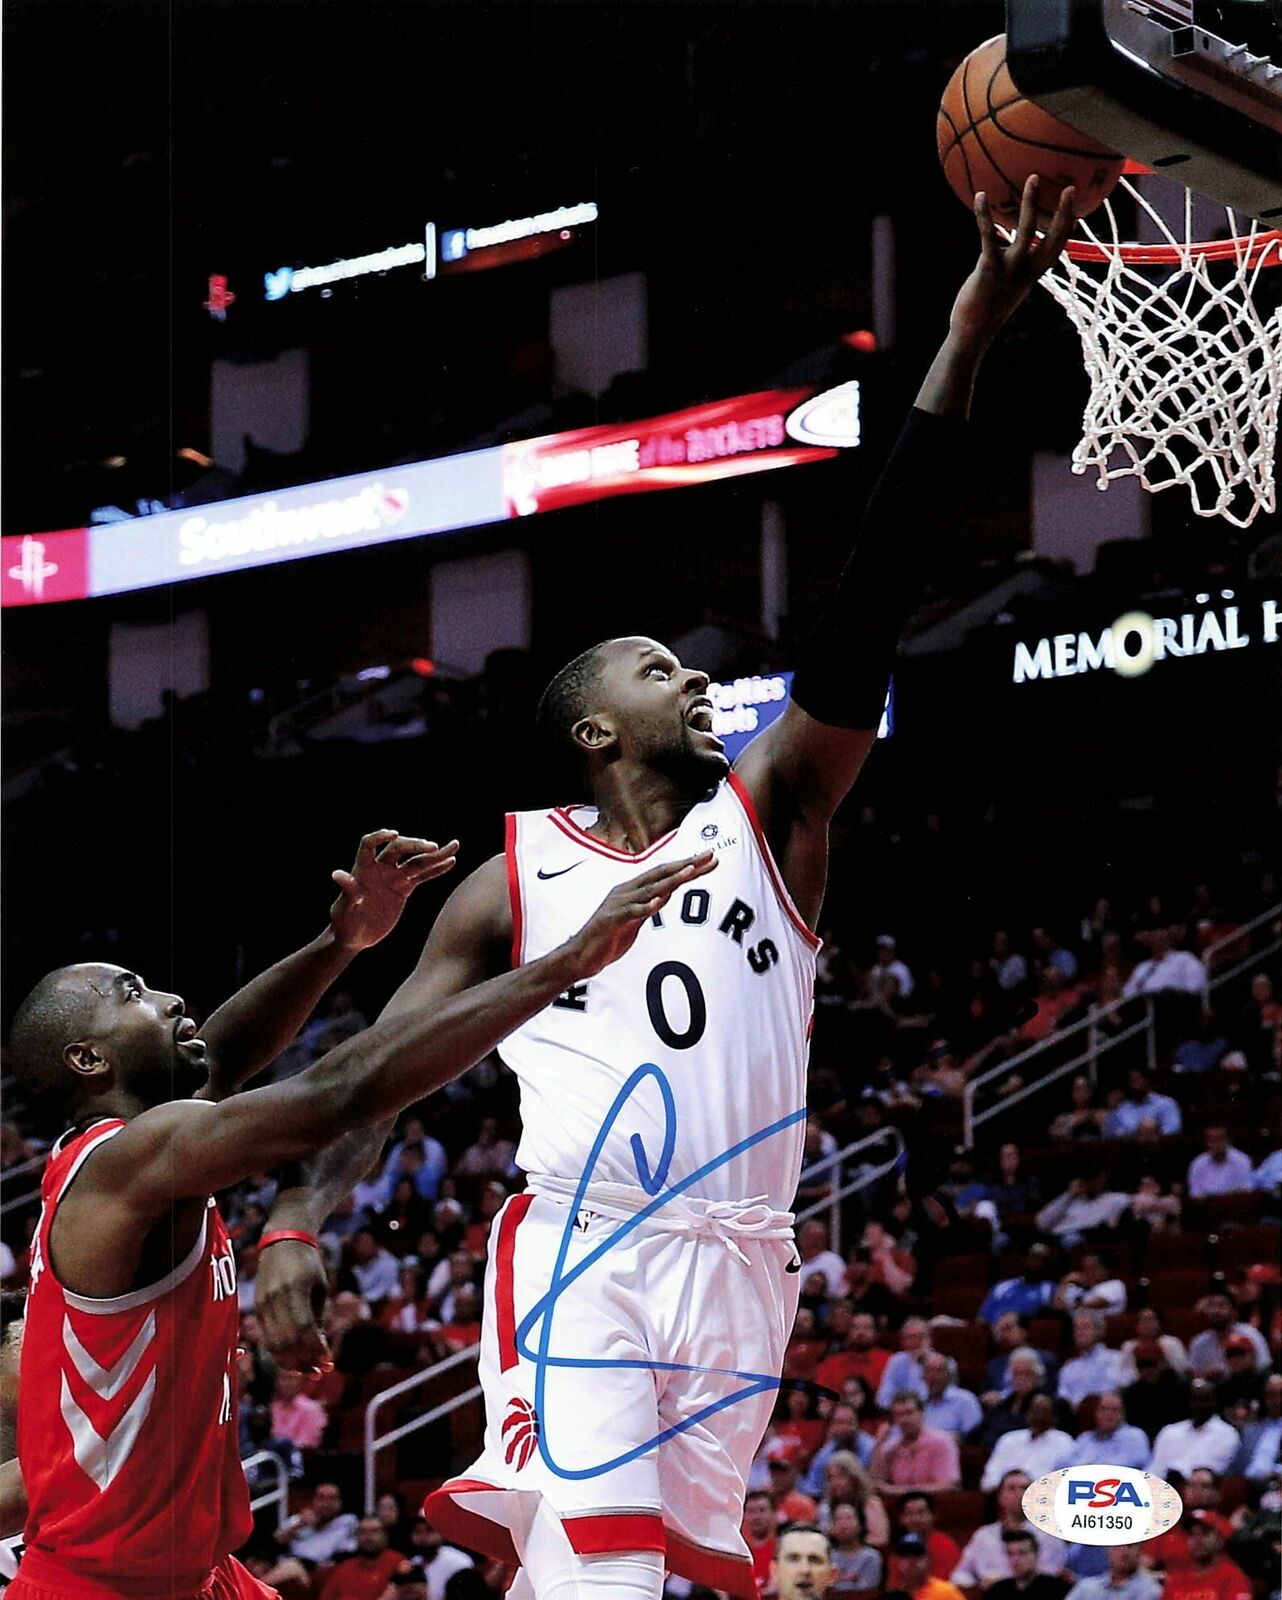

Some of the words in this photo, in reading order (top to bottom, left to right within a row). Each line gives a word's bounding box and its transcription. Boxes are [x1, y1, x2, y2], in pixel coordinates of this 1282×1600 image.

[1012, 605, 1250, 684] MEMORIAL
[646, 960, 707, 1050] 0
[1067, 1478, 1144, 1508] PSA
[1071, 1514, 1133, 1530] AI61350
